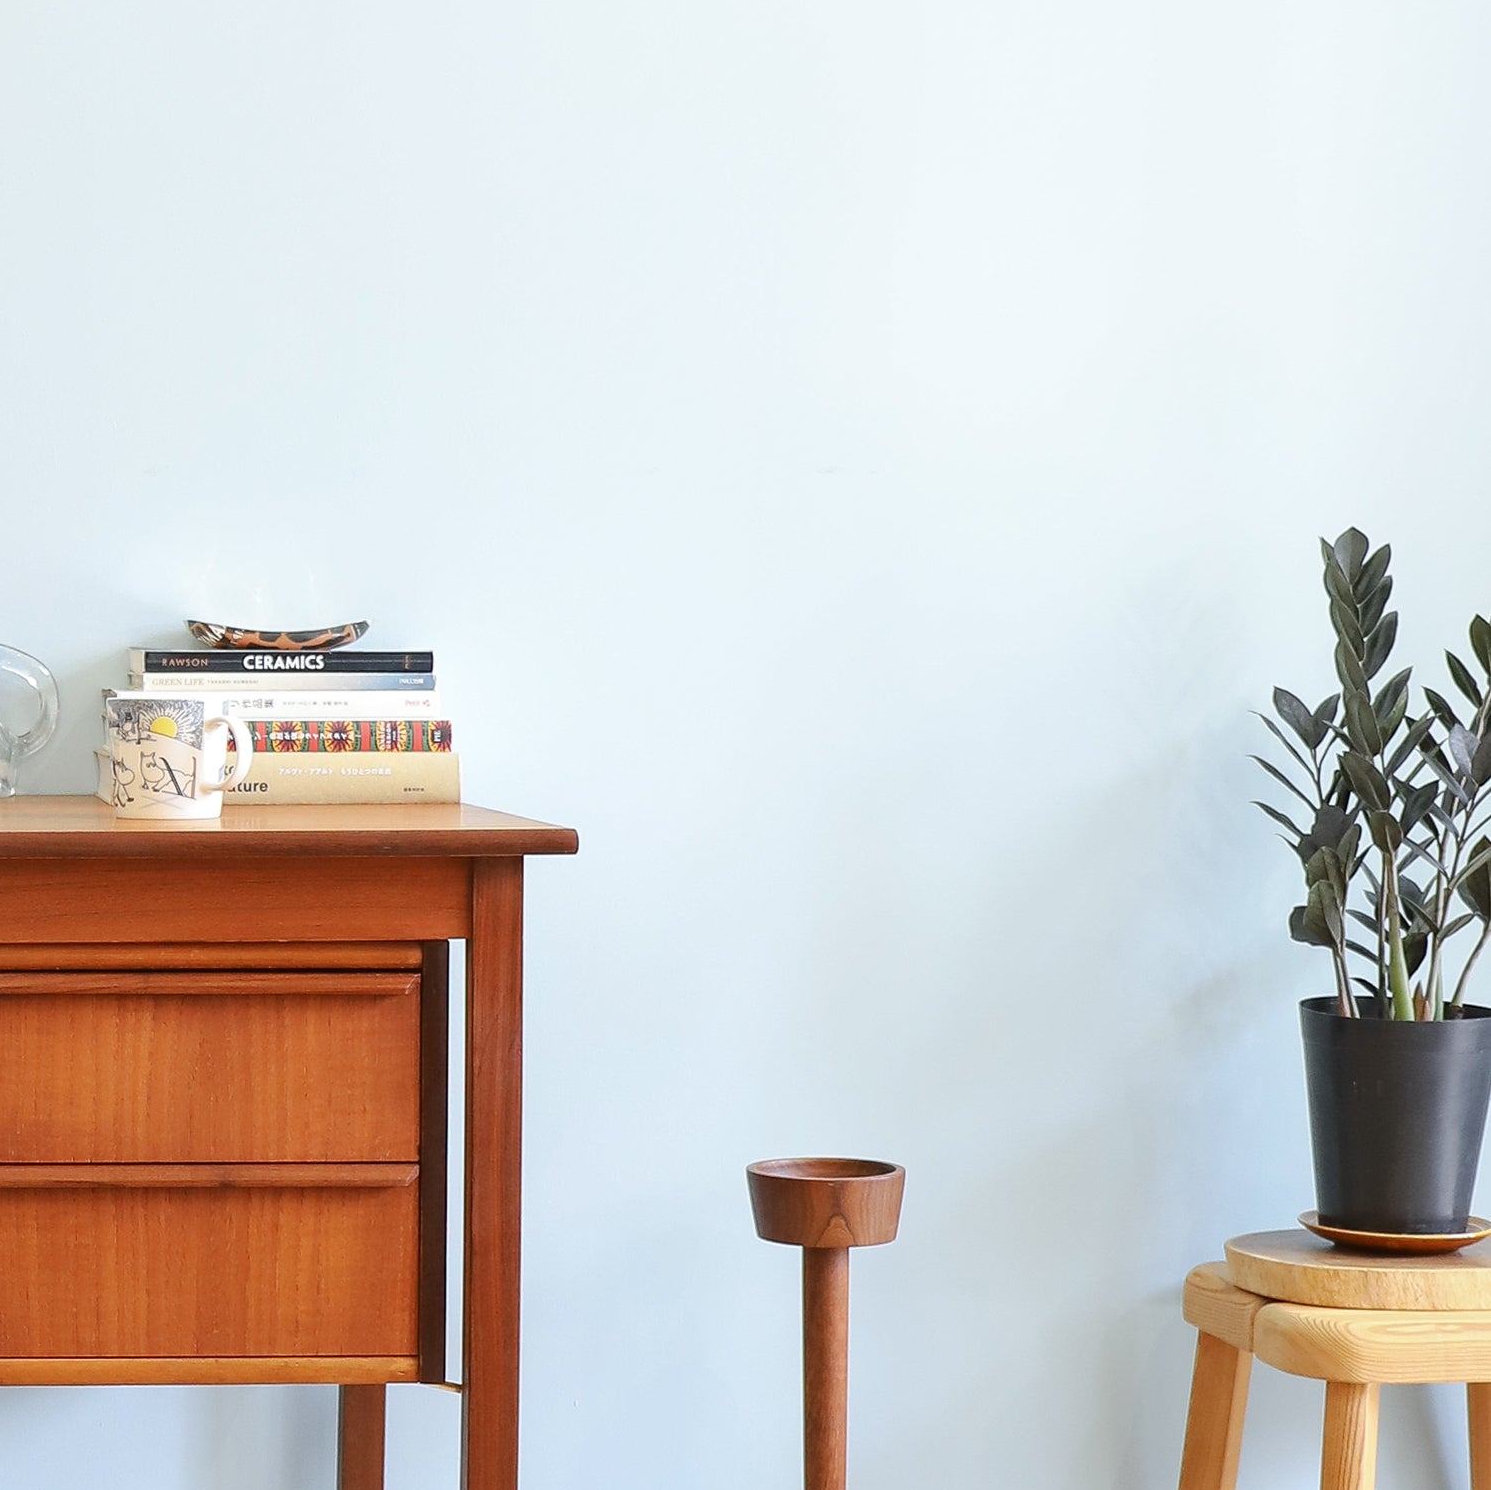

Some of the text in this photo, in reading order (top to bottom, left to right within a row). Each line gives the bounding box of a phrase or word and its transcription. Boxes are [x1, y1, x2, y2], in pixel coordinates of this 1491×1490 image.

[162, 655, 325, 670] RAWSON CERAMICS
[152, 678, 183, 686] GREEN
[184, 678, 204, 686] LIFE
